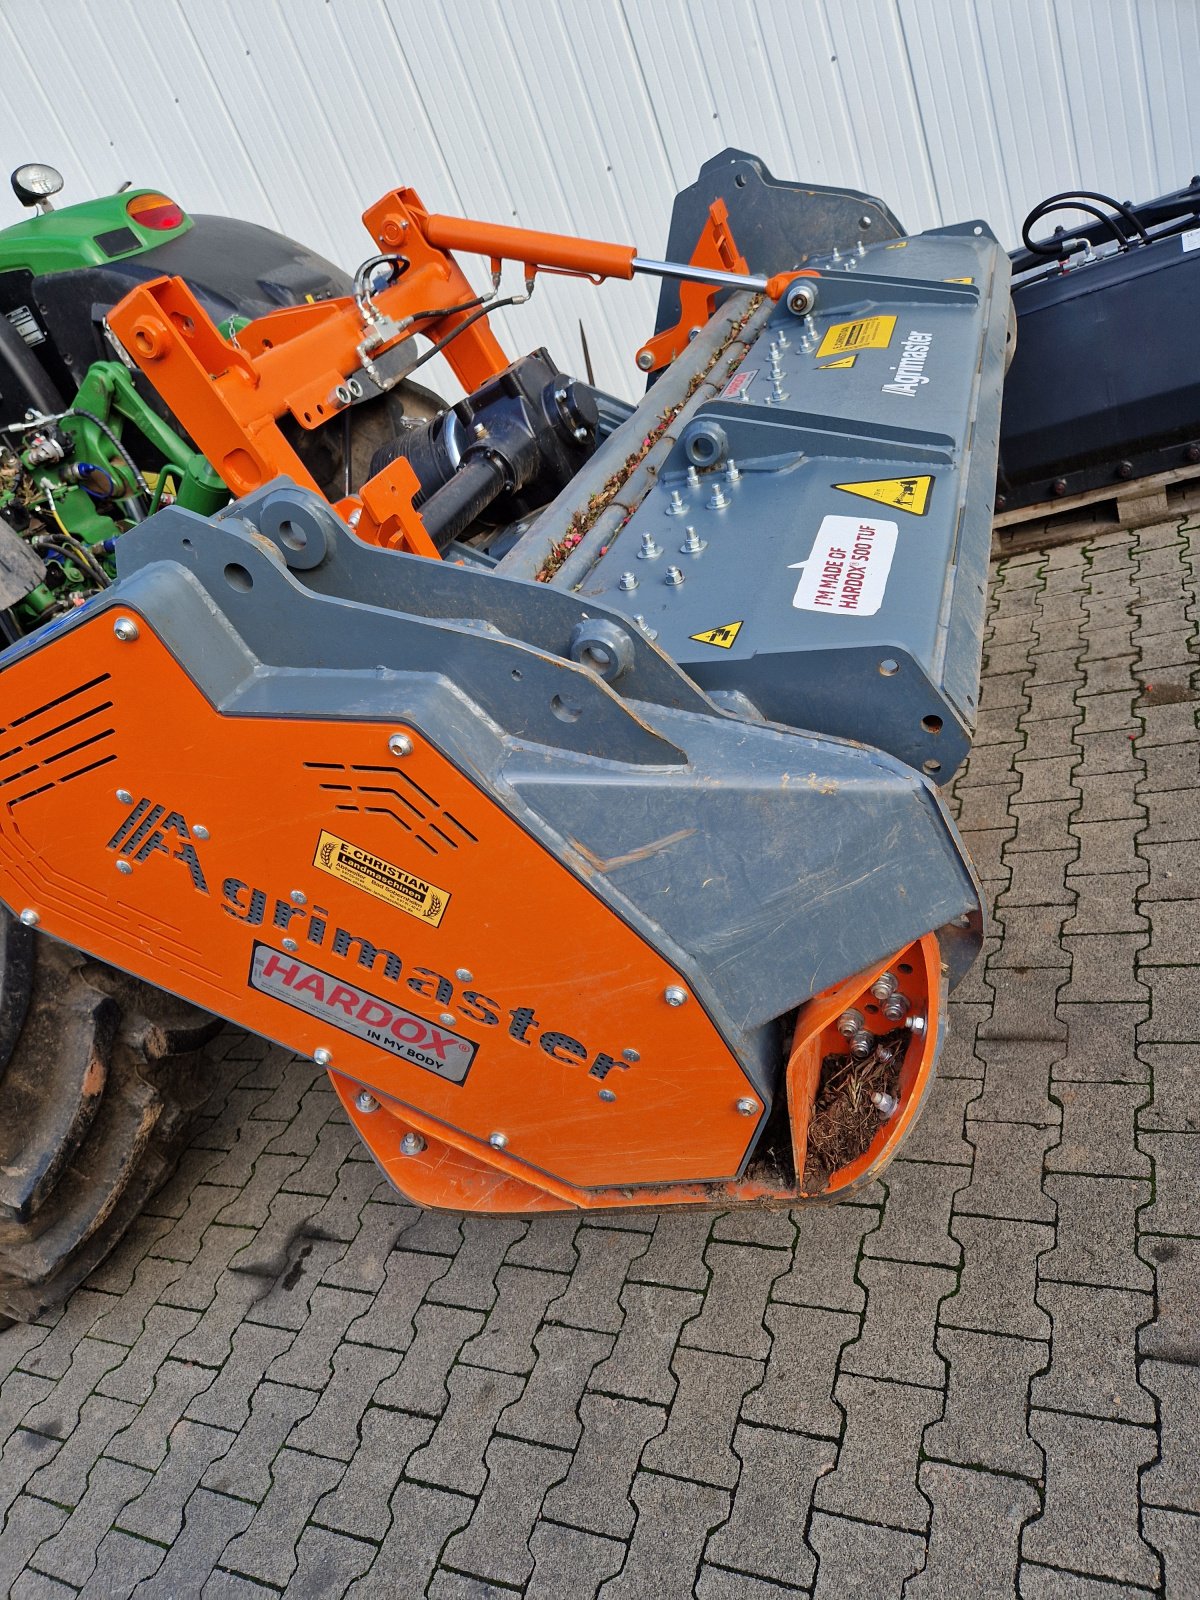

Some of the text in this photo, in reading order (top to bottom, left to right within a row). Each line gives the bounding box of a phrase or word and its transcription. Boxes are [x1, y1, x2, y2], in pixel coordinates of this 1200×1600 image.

[881, 330, 933, 397] Agrimaster
[851, 543, 872, 562] 500
[857, 525, 876, 541] TUF
[814, 547, 847, 606] I'M MADE OF
[341, 855, 421, 900] Landmaschinen
[106, 797, 633, 1082] Agrimaster
[367, 1029, 444, 1070] IN MY BODY
